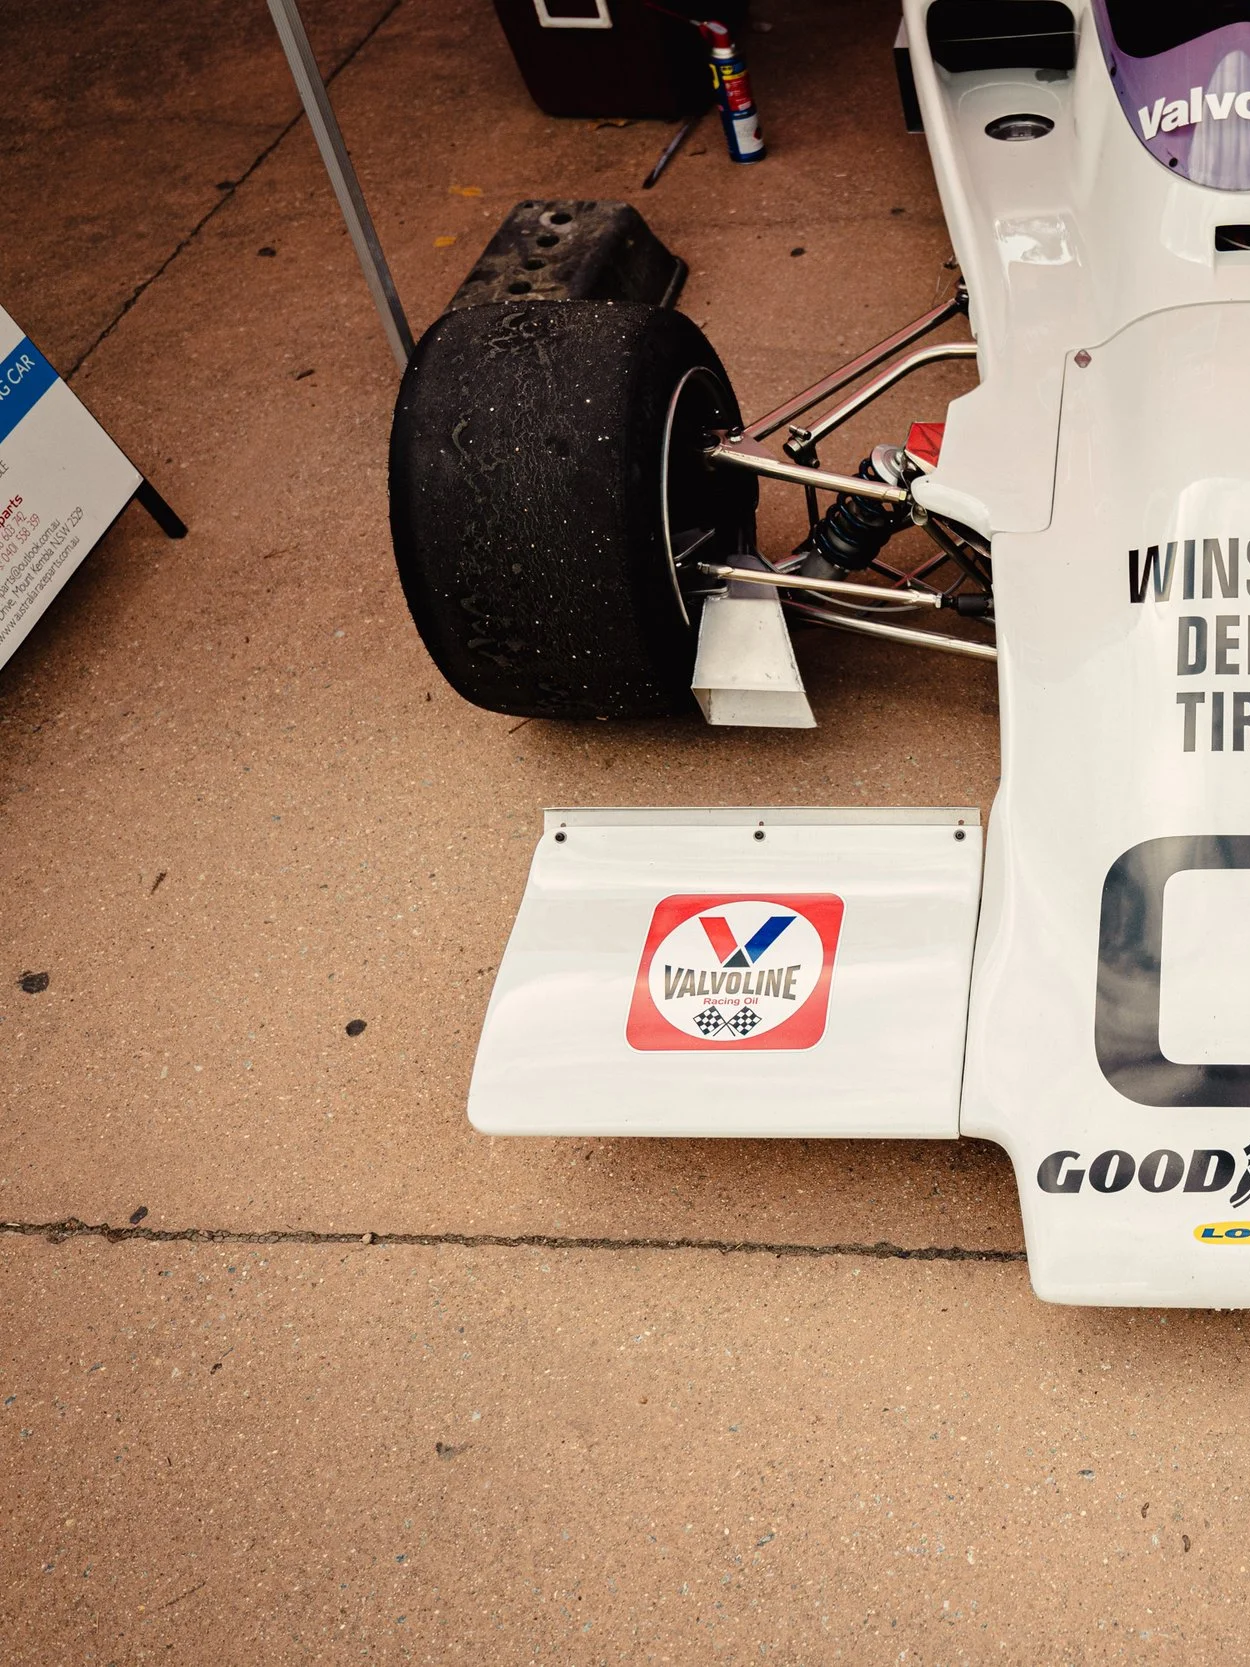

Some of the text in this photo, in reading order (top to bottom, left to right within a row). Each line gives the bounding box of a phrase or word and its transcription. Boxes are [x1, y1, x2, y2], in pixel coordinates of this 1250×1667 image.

[7, 354, 35, 384] CAR
[1, 511, 28, 542] 603 742
[15, 527, 31, 544] 558
[27, 513, 41, 531] 359
[11, 572, 35, 598] Mount
[30, 548, 55, 575] Kembla
[67, 506, 84, 528] 2529
[664, 964, 802, 1001] VALVOLINE
[703, 997, 758, 1007] Racing Oil
